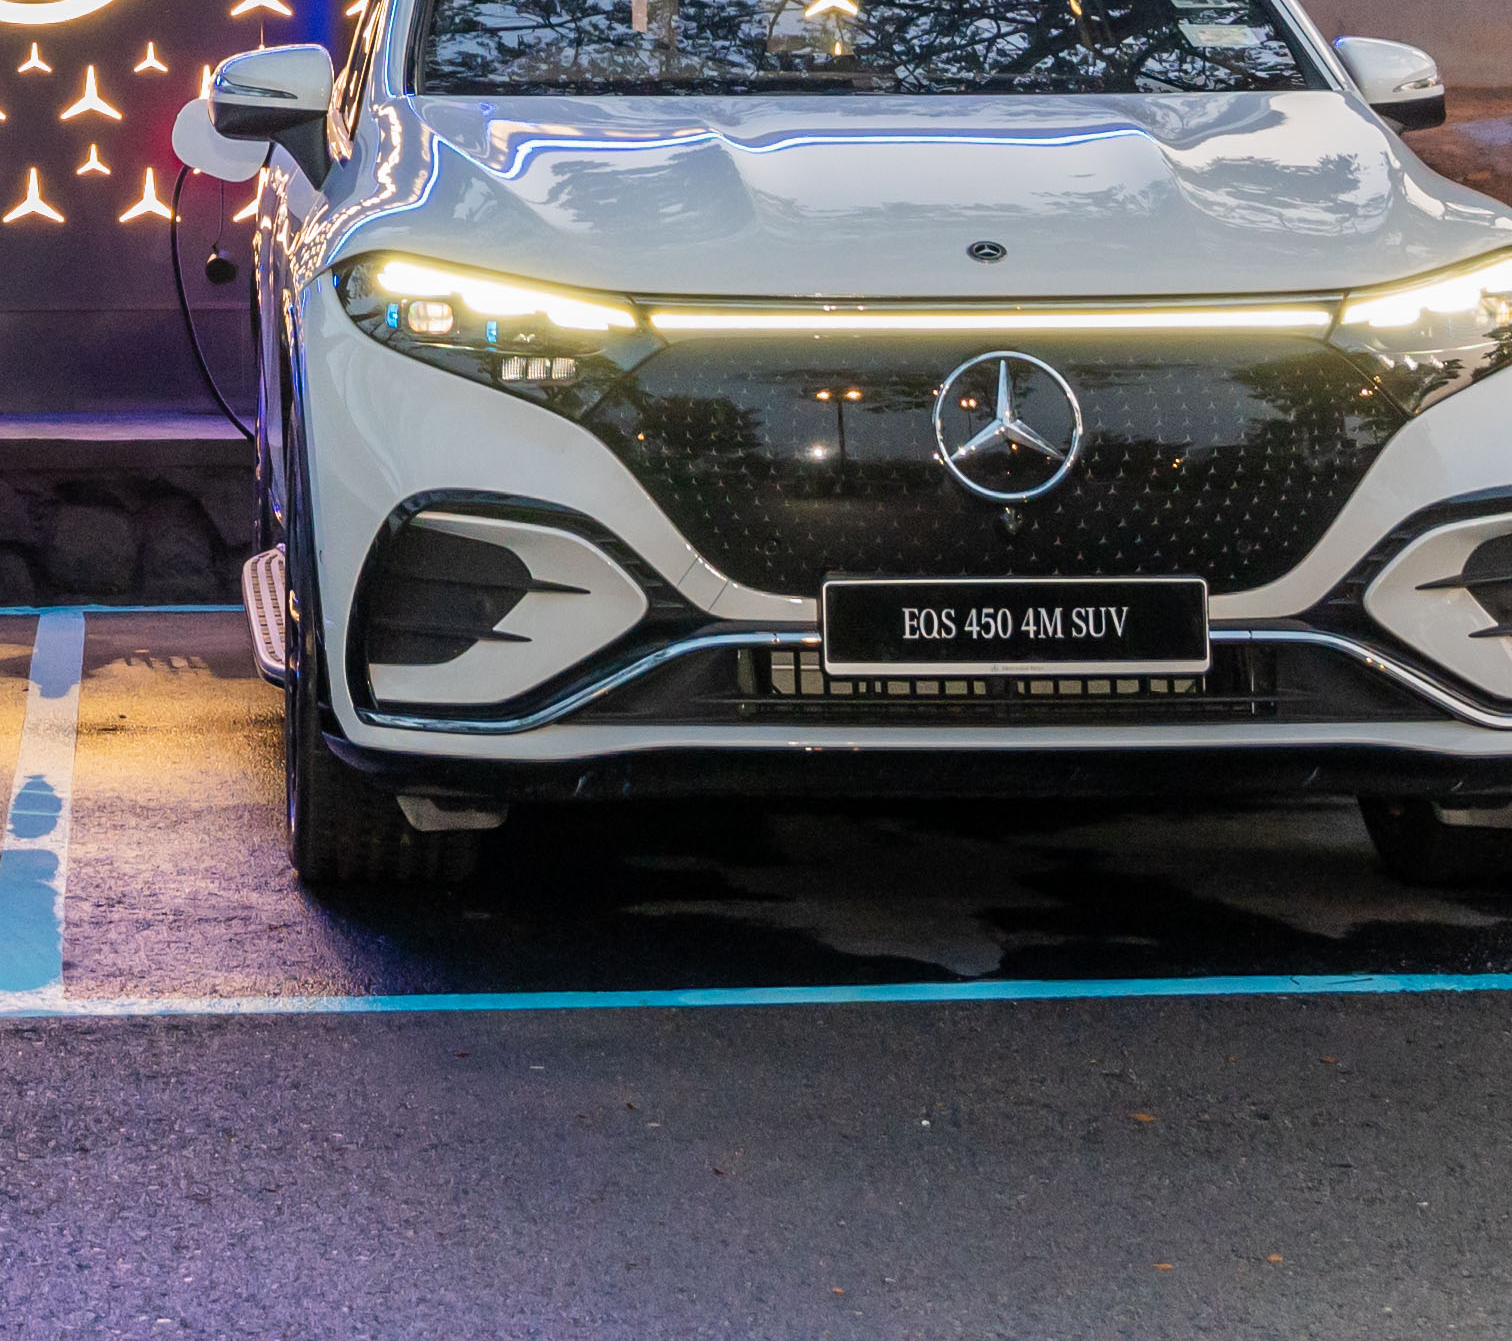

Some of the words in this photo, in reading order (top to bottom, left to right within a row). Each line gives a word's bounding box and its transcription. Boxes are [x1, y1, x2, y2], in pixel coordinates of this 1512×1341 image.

[901, 607, 957, 640] EQS
[964, 608, 1013, 639] 450
[1020, 608, 1065, 639] 4M
[1071, 606, 1129, 638] SUV
